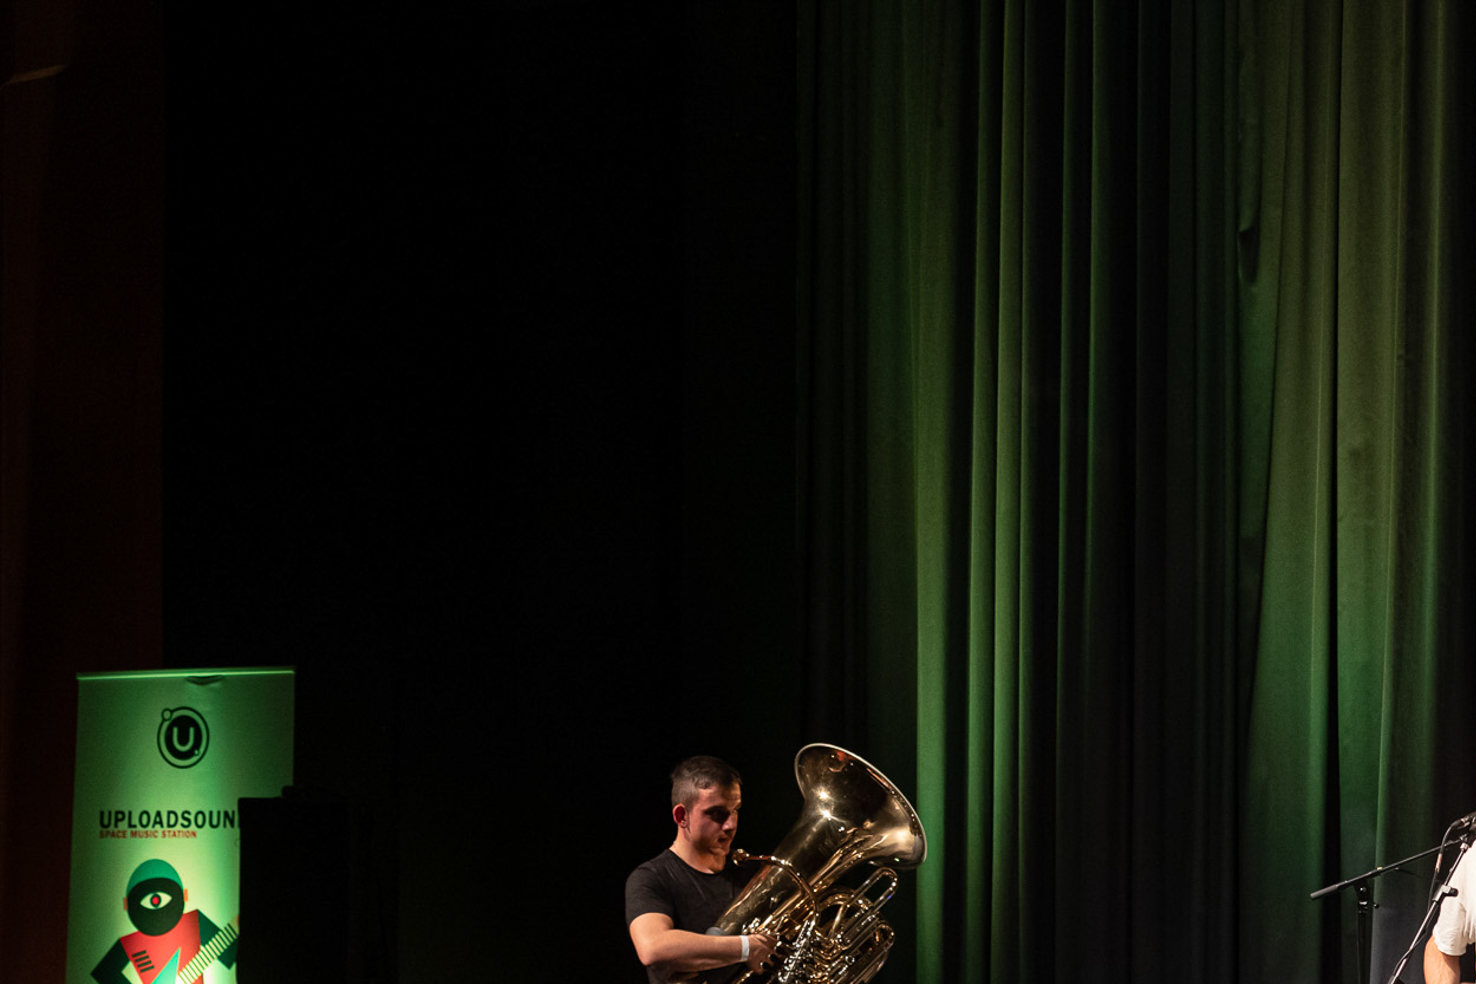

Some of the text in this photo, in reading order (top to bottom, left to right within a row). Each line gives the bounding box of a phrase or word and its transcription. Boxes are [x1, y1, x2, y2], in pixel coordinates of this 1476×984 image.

[99, 810, 238, 829] UPLOADSOUN
[100, 830, 197, 839] SPACE MUSIC STATION
